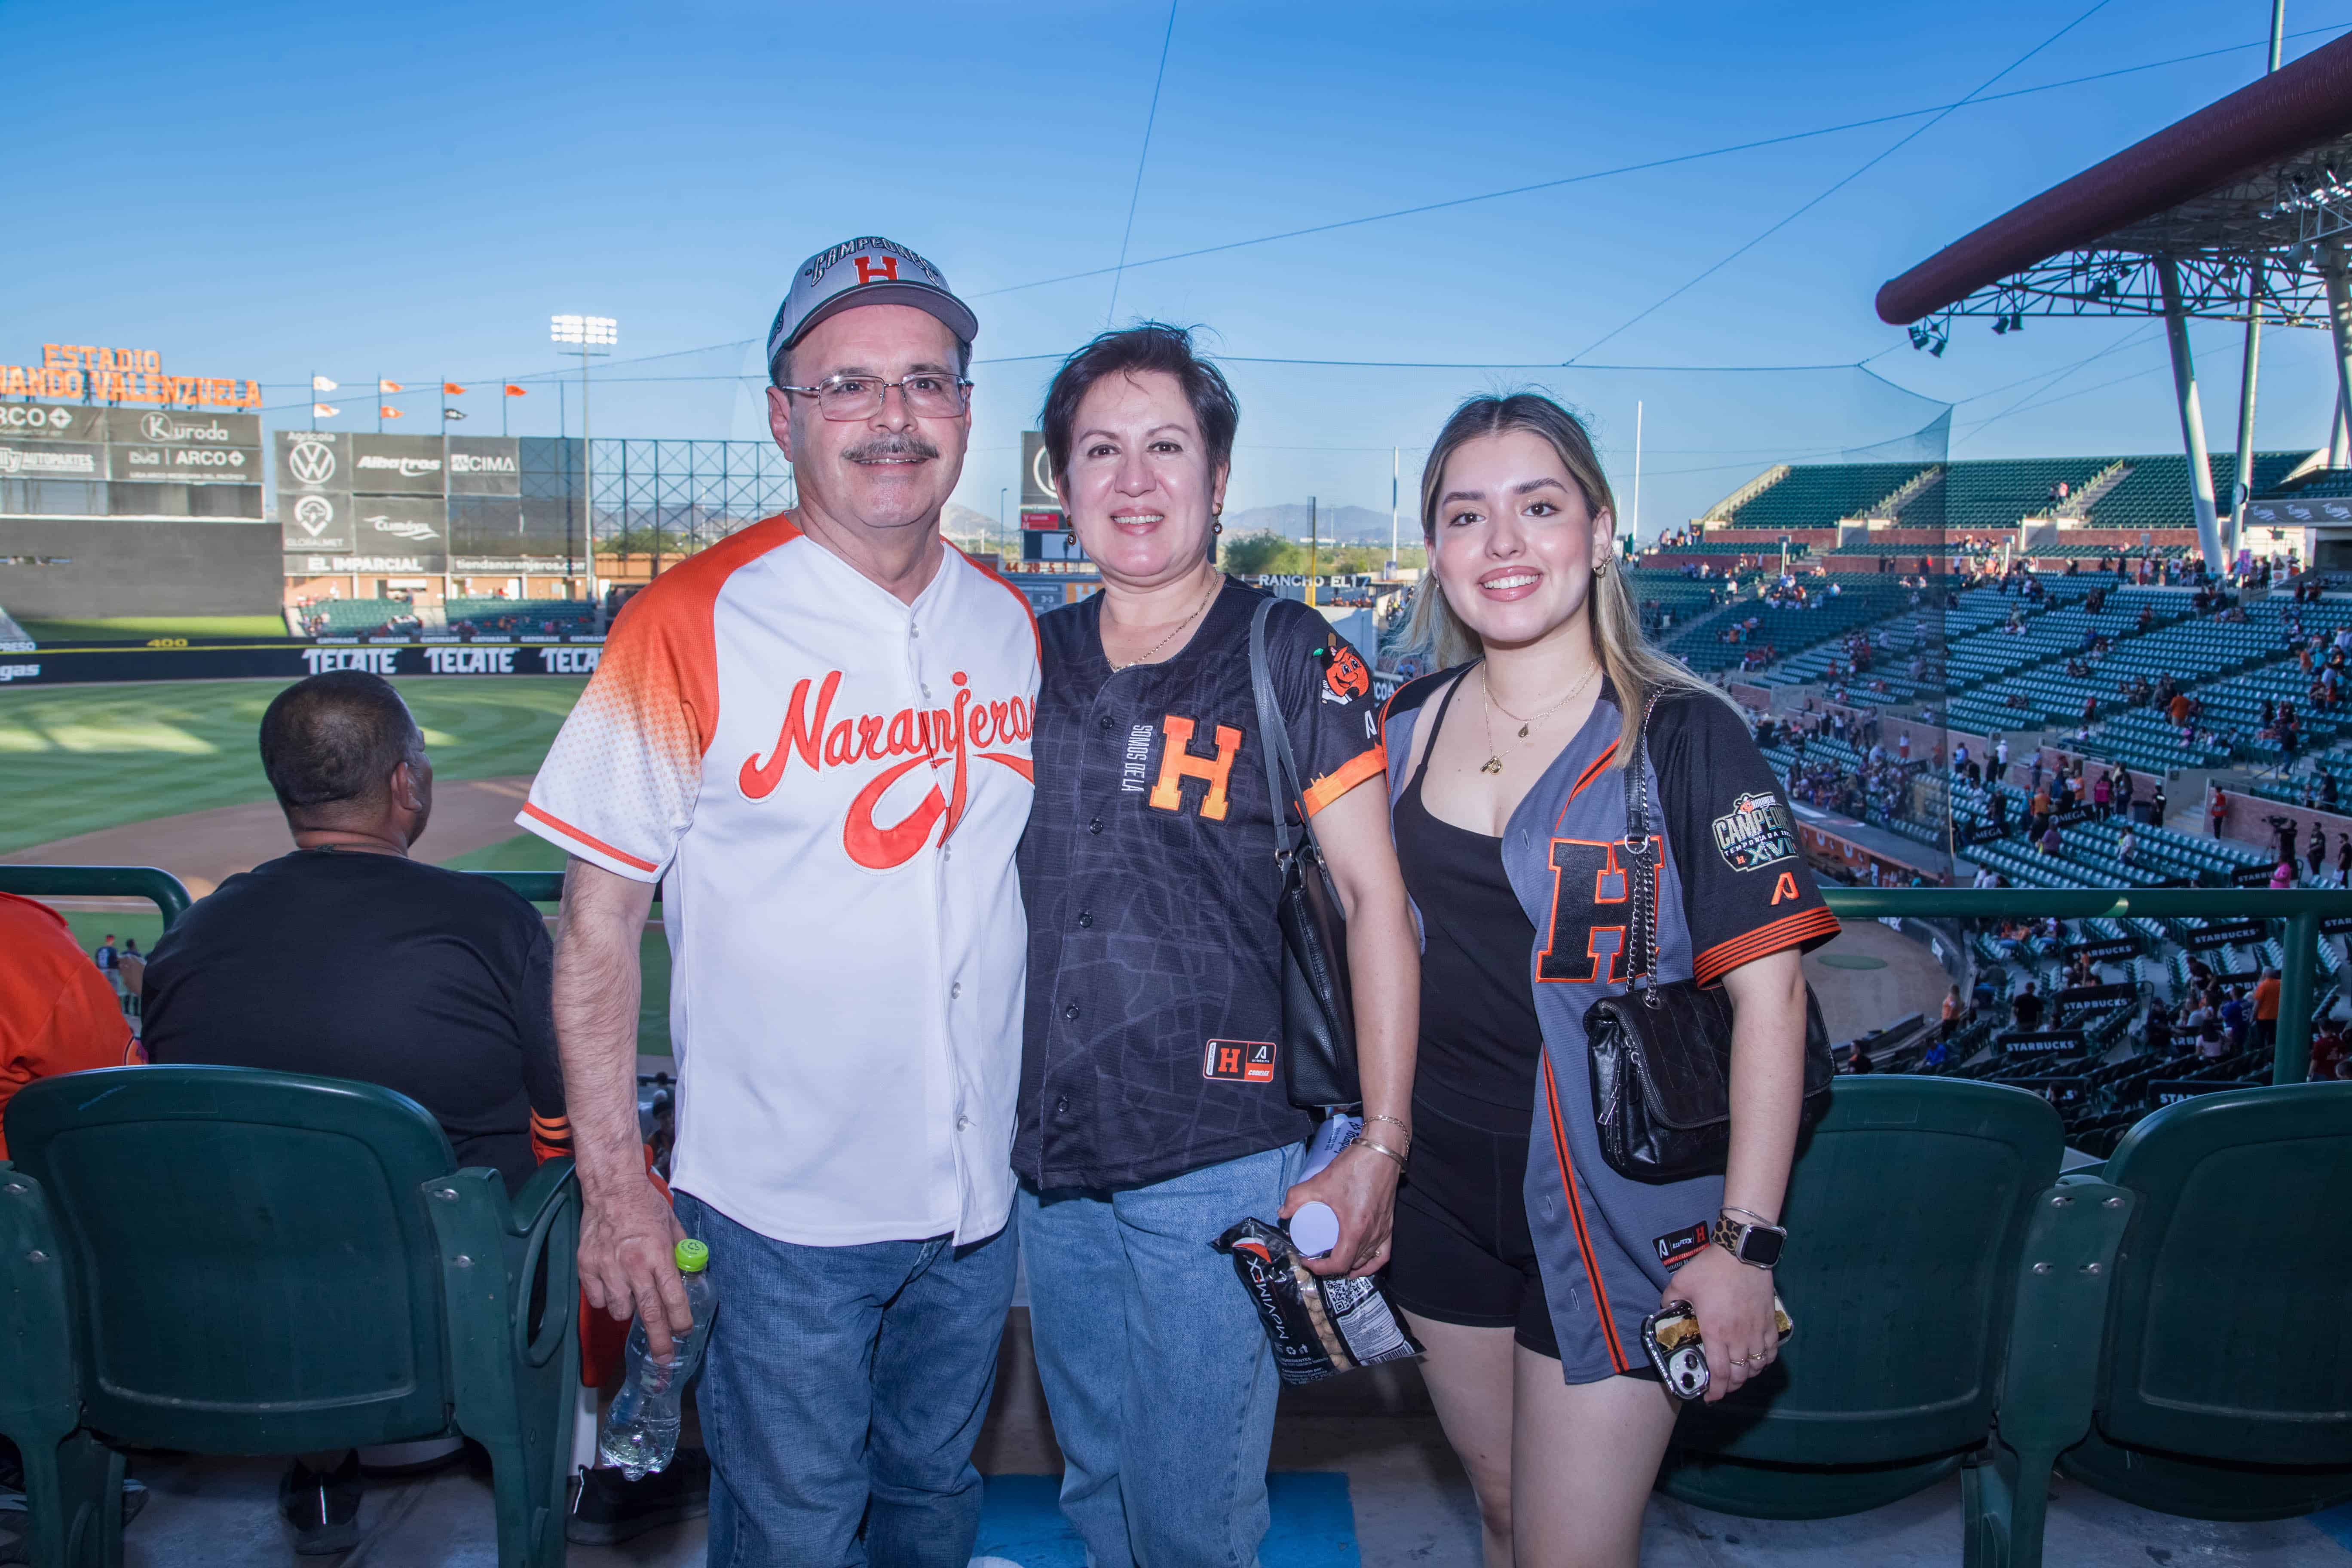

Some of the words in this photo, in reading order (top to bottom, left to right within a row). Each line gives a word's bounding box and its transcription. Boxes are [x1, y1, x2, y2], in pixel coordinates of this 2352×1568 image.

[811, 236, 939, 287] CAMPEONES
[852, 255, 899, 286] H
[43, 343, 161, 374] ESTADIO
[89, 369, 262, 407] VALENZUELA
[149, 415, 229, 441] Kuroda
[175, 450, 227, 466] ARCO
[357, 456, 442, 477] Albatros
[469, 456, 516, 472] CIMA
[307, 557, 331, 571] EL
[332, 557, 424, 572] IMPARCIAL
[1259, 574, 1324, 587] RANCHO
[1330, 576, 1351, 588] EL
[147, 638, 188, 646] 400
[301, 648, 402, 675] TECATE
[423, 647, 521, 673] TECATE
[1126, 725, 1153, 760] SOMOS
[1124, 763, 1145, 778] DE
[1149, 715, 1242, 821] H
[1121, 778, 1144, 791] LA
[1724, 831, 1779, 857] TEMPORADA
[1535, 836, 1665, 984] H
[2194, 928, 2257, 944] STARBUCKS
[2063, 998, 2128, 1011] STARBUCKS
[2006, 1040, 2075, 1052] STARBUCKS
[1218, 1048, 1240, 1073] H
[1696, 1225, 1706, 1243] H
